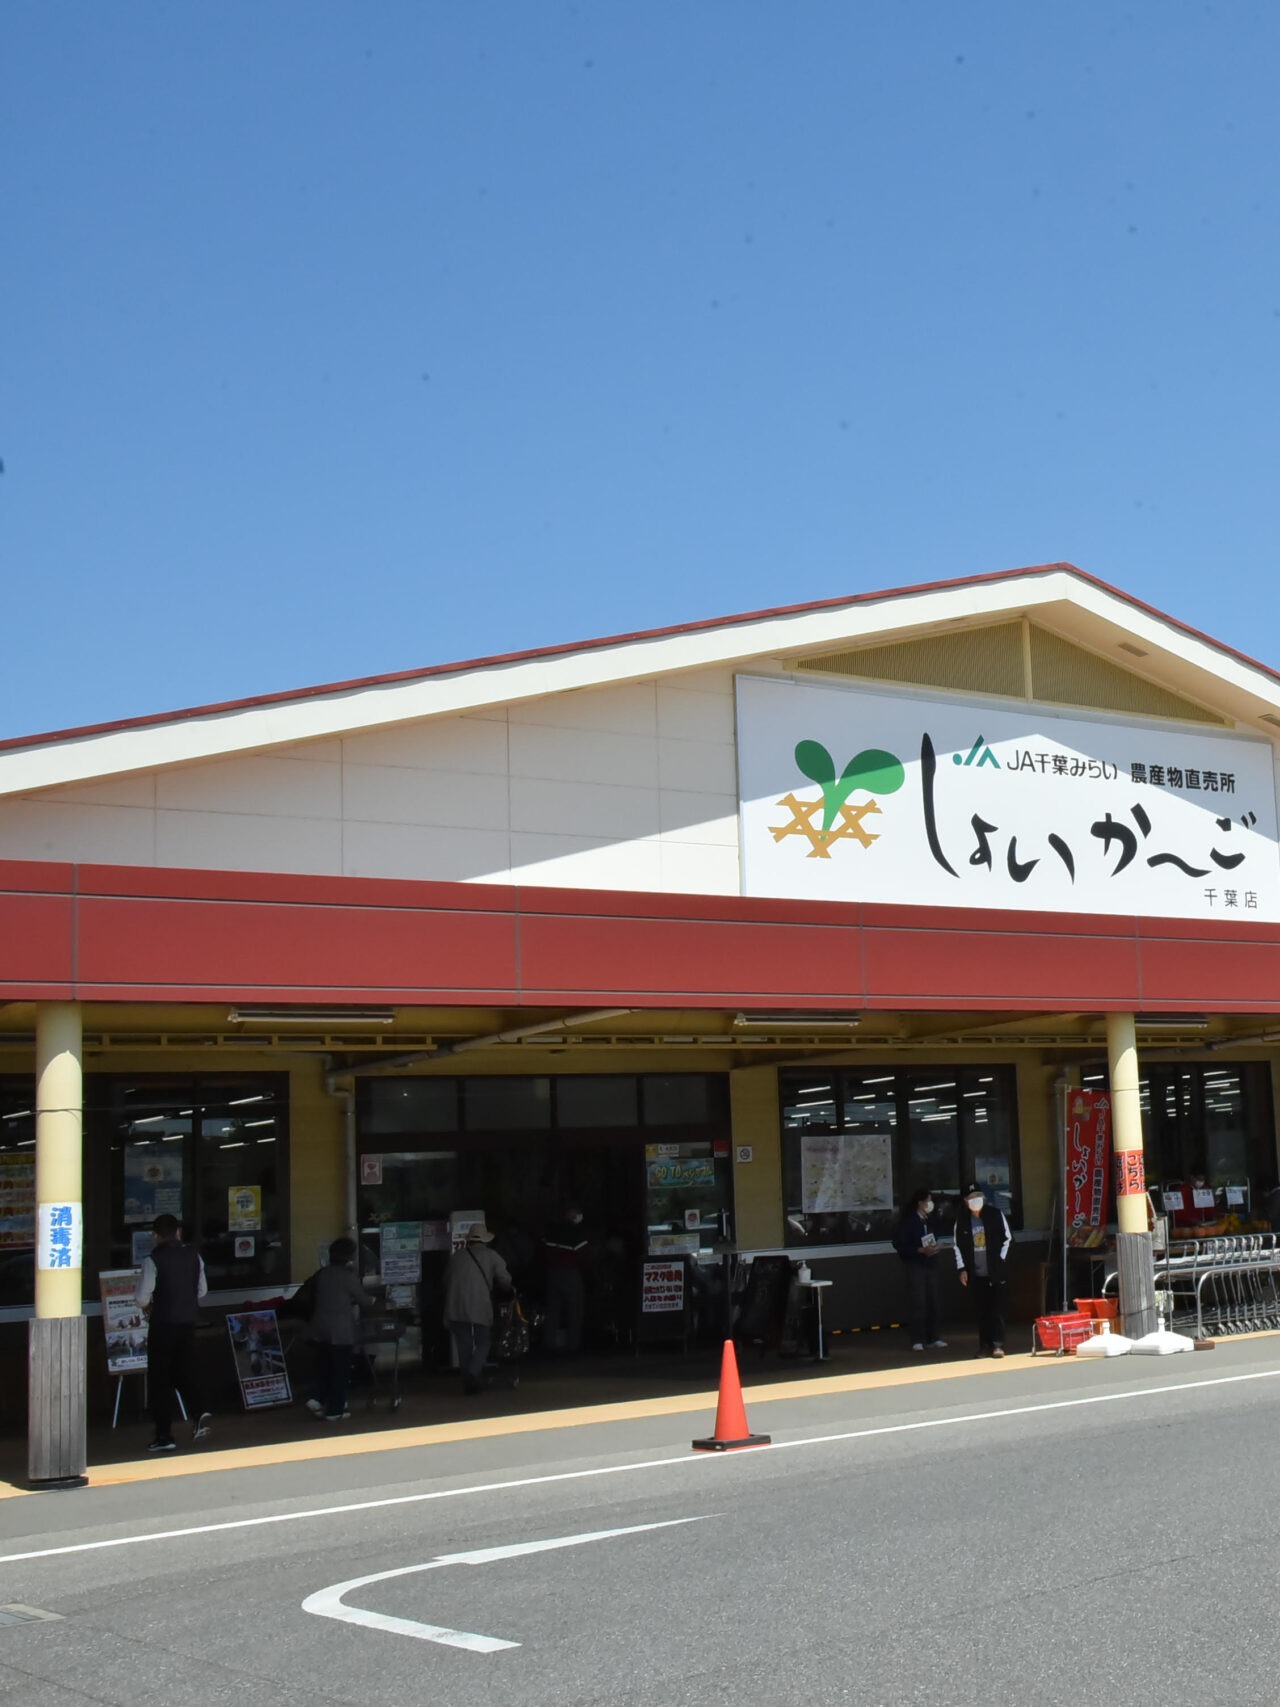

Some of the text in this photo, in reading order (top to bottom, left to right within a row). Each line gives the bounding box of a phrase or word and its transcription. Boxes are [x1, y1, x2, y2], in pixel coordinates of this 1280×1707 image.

[1006, 750, 1236, 794] JA千葉みらい 農産物直売所
[1203, 888, 1258, 909] 千葉店
[1126, 1154, 1141, 1191] こちら
[49, 1206, 73, 1268] 消毒済
